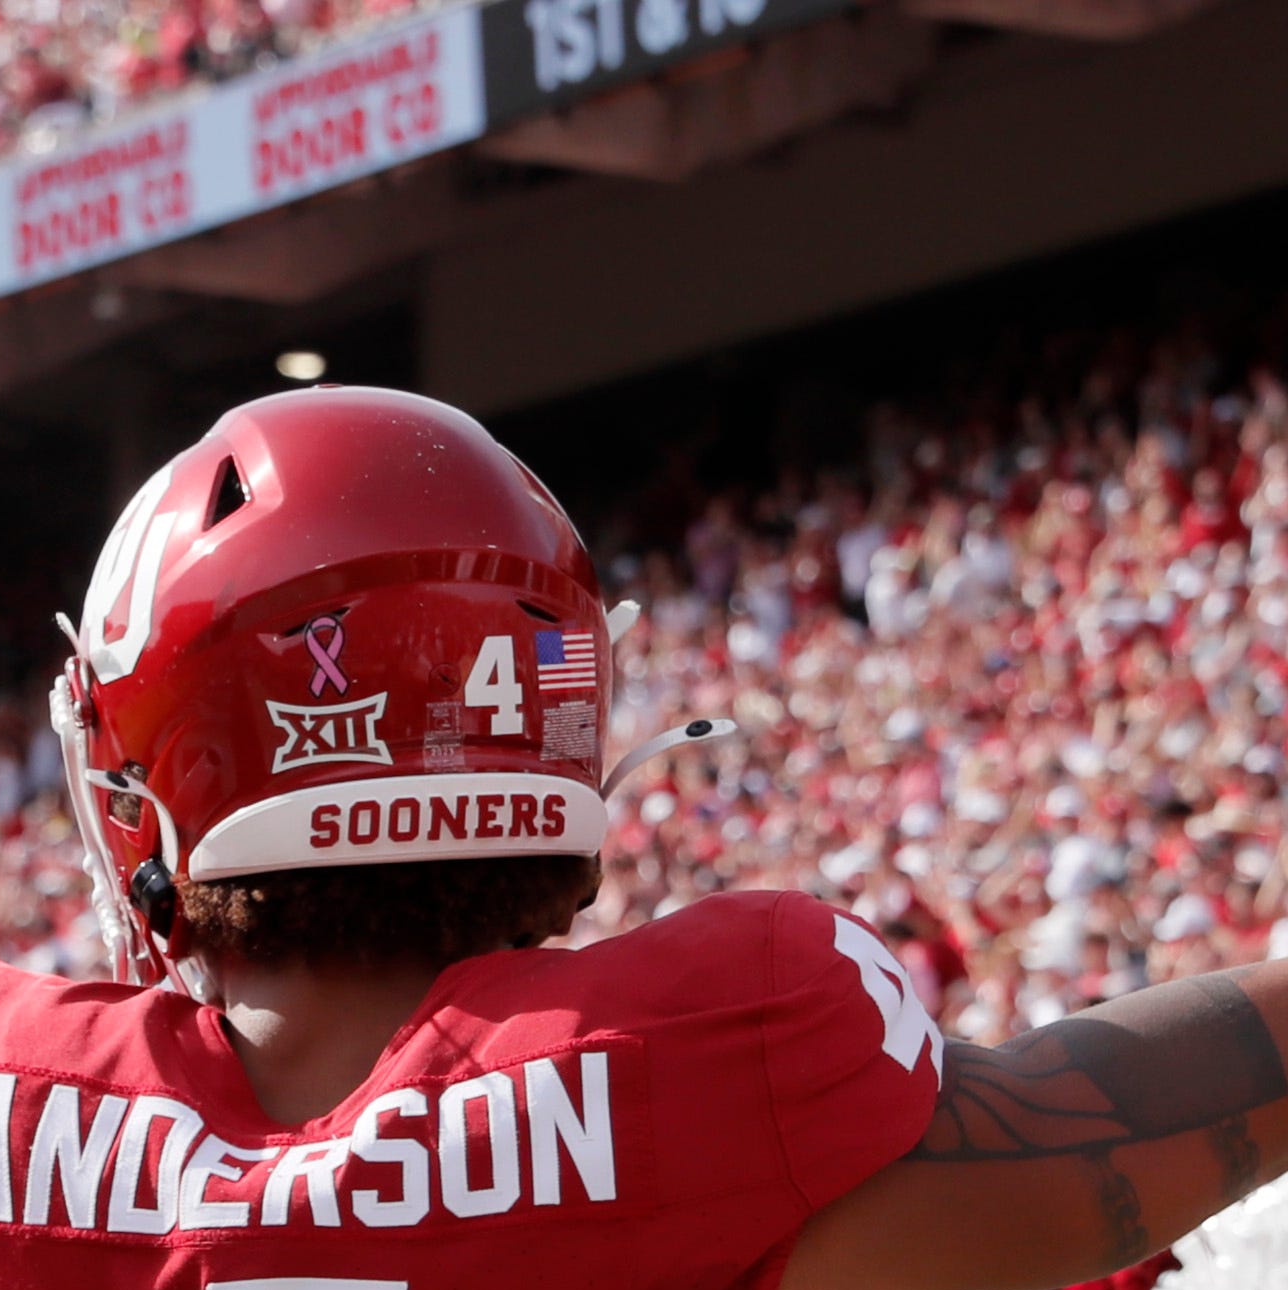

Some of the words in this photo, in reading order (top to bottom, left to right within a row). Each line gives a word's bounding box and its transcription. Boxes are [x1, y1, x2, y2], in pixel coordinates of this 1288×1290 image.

[253, 106, 365, 192] DOOR
[15, 191, 123, 270] DOOR
[464, 635, 524, 736] 4
[274, 700, 385, 767] XII
[310, 794, 567, 849] SOONERS
